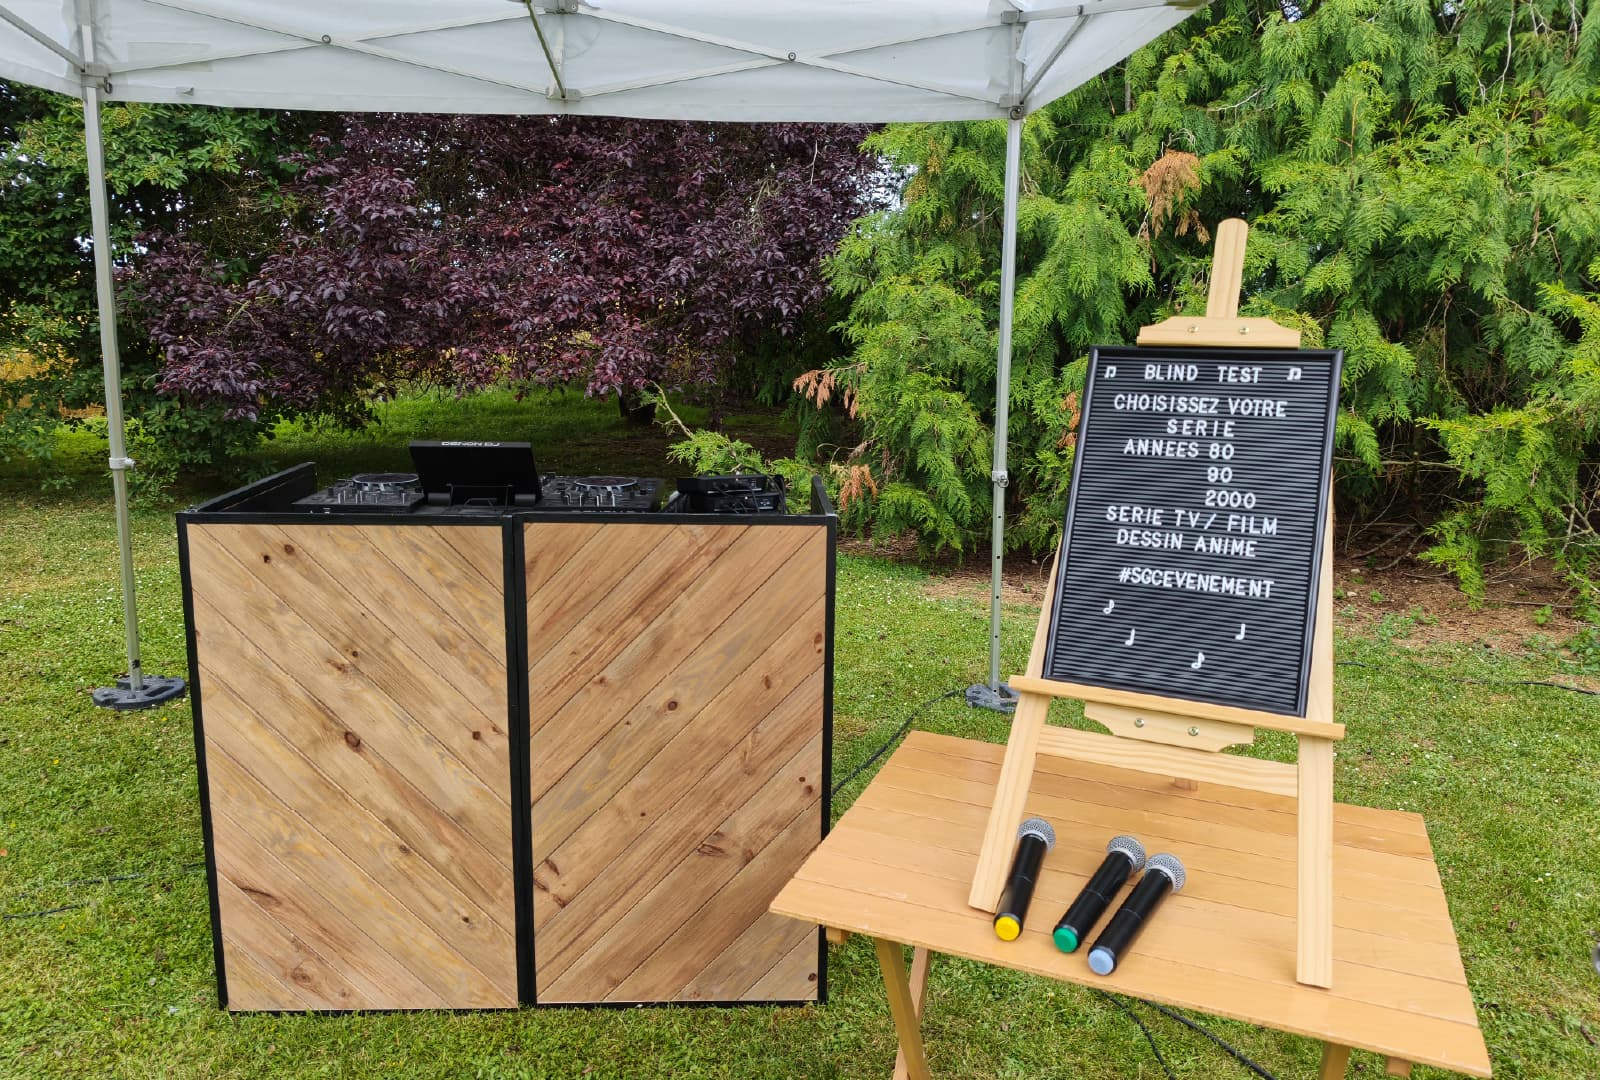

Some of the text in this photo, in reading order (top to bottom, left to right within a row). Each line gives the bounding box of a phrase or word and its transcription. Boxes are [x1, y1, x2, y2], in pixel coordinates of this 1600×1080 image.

[1144, 364, 1263, 383] BLIND TEST
[1114, 394, 1288, 418] CHOISISSEZ VOTRE
[1167, 419, 1235, 437] SERIE
[1124, 439, 1235, 460] ANNEES 80
[1207, 467, 1233, 483] 90
[1205, 490, 1256, 509] 2000
[1106, 506, 1164, 526] SERIE
[1227, 515, 1278, 536] FILM
[1116, 529, 1258, 558] DESSIN ANIME
[1118, 567, 1275, 598] #SGCEVENEMENT
